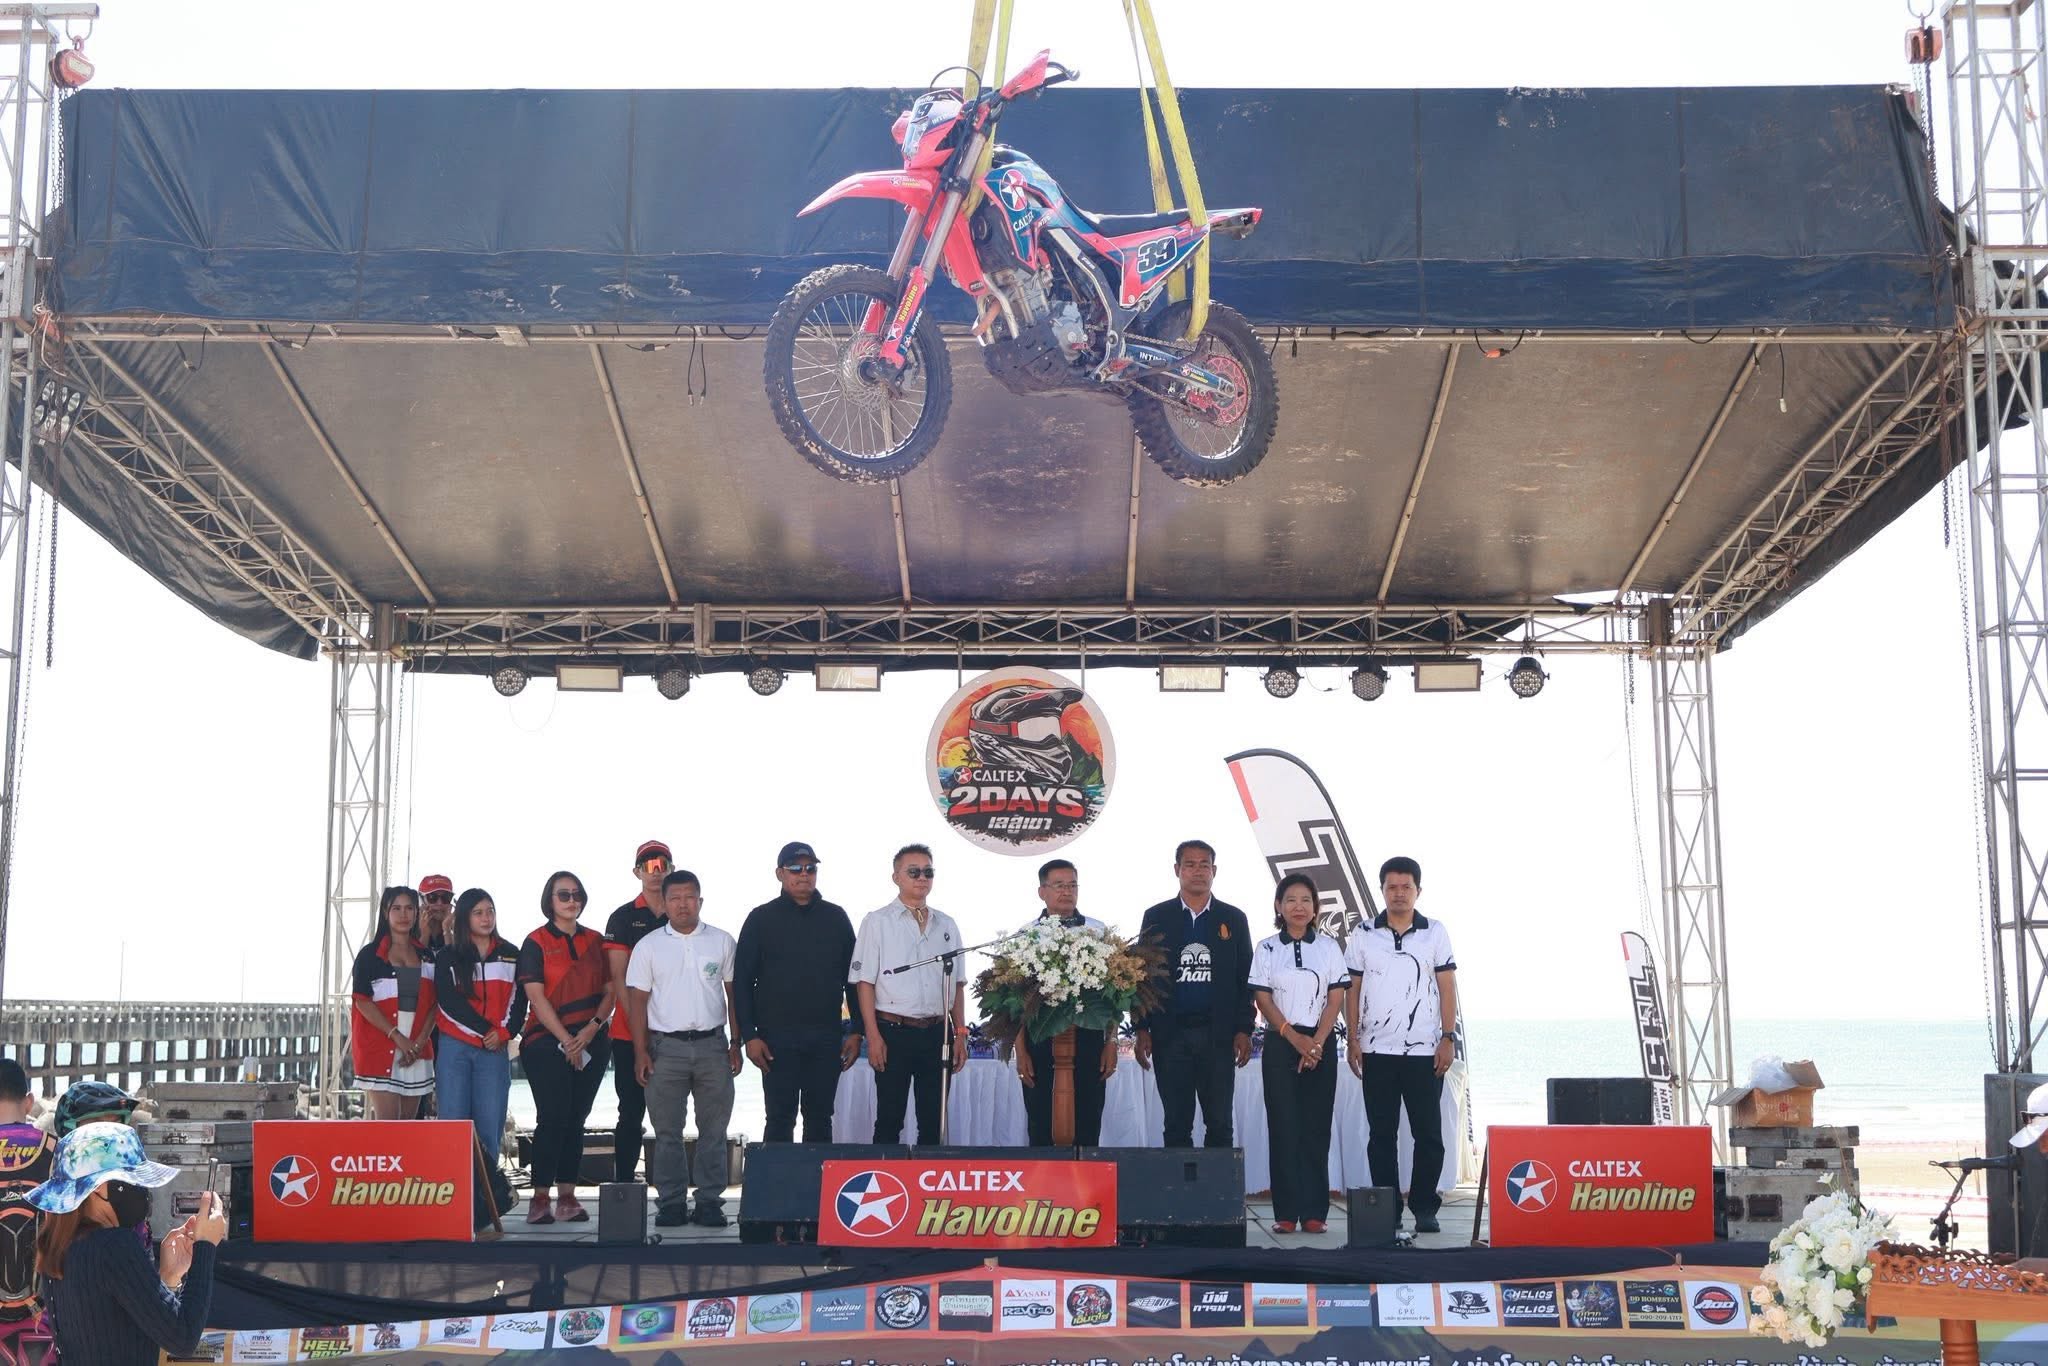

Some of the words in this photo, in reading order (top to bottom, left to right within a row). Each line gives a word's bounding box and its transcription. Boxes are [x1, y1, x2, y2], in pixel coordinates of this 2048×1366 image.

[898, 284, 918, 322] Havoline
[973, 770, 1026, 783] CALTEX
[950, 786, 1086, 818] 2DAYS
[330, 1156, 403, 1173] CALTEX
[1568, 1160, 1643, 1177] CALTEX
[919, 1170, 1025, 1192] CALTEX
[330, 1177, 455, 1206] Havoline
[1568, 1182, 1696, 1212] Havoline
[915, 1198, 1101, 1239] Havoline
[1015, 1289, 1051, 1298] YASAKI
[1512, 1290, 1554, 1299] HELIOS
[1641, 1295, 1680, 1303] HOMESTAY
[1505, 1305, 1556, 1313] HELIOS
[303, 1339, 351, 1350] HELL
